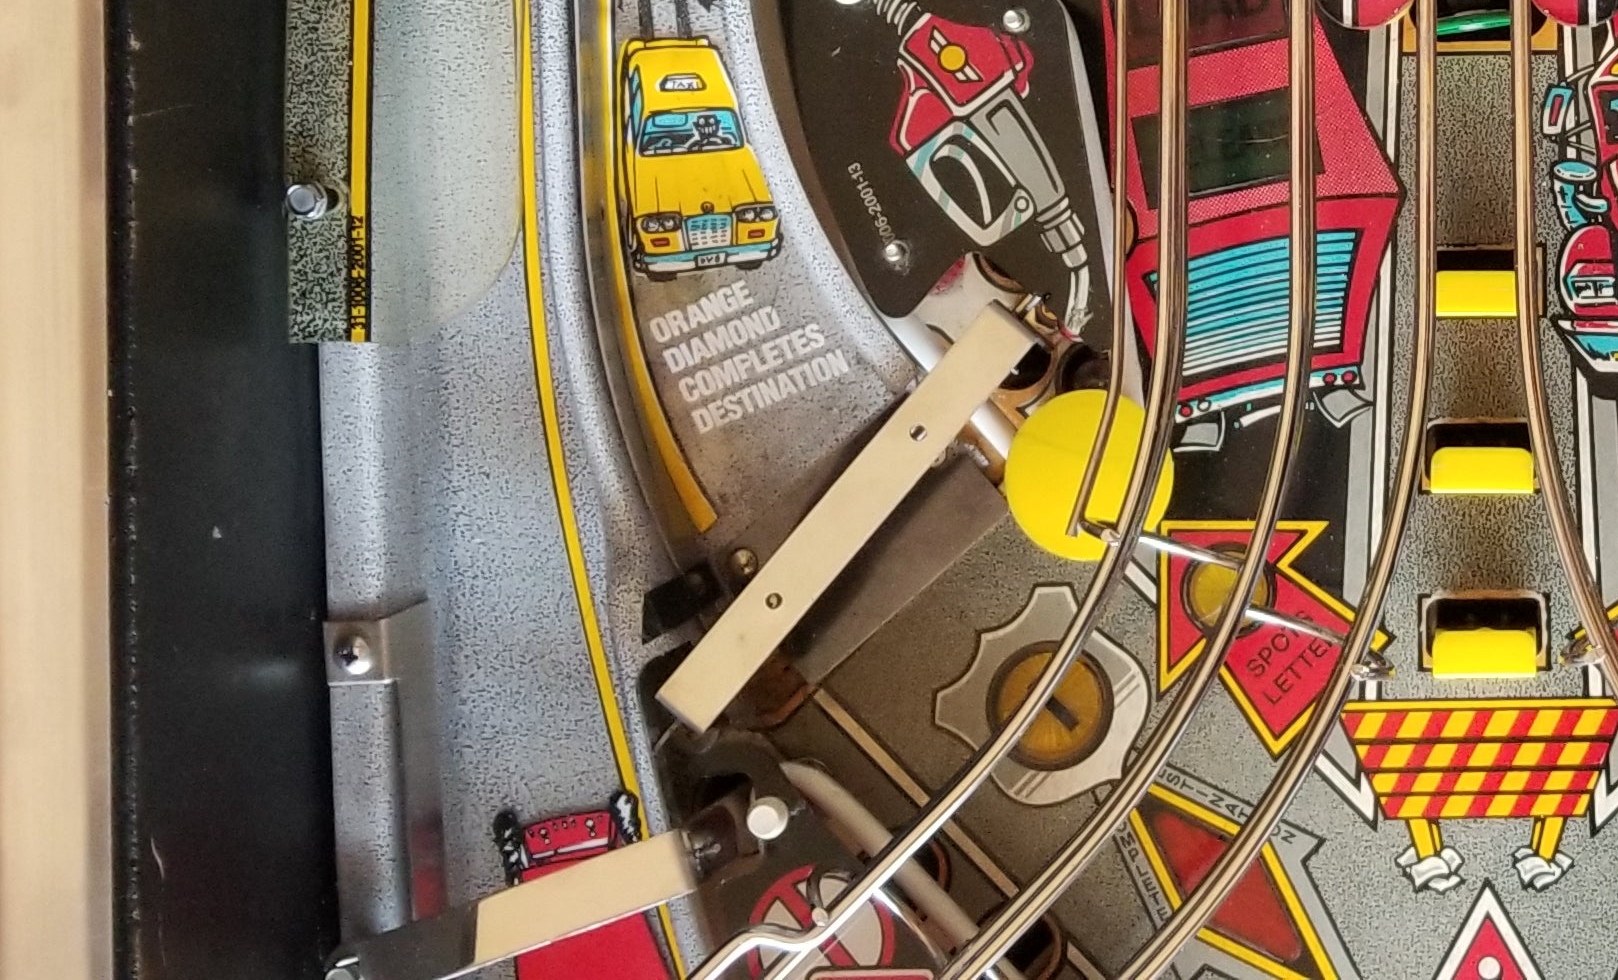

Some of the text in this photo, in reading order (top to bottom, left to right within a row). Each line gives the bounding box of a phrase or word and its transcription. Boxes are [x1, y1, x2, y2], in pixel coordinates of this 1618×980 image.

[672, 80, 700, 90] TAXI
[650, 279, 754, 343] ORANGE
[662, 305, 781, 374] DIAMOND
[678, 323, 826, 403] COMPLETES
[691, 348, 850, 435] DESTINATION
[1262, 637, 1333, 705] LETTE
[1114, 821, 1174, 922] OMPLETE
